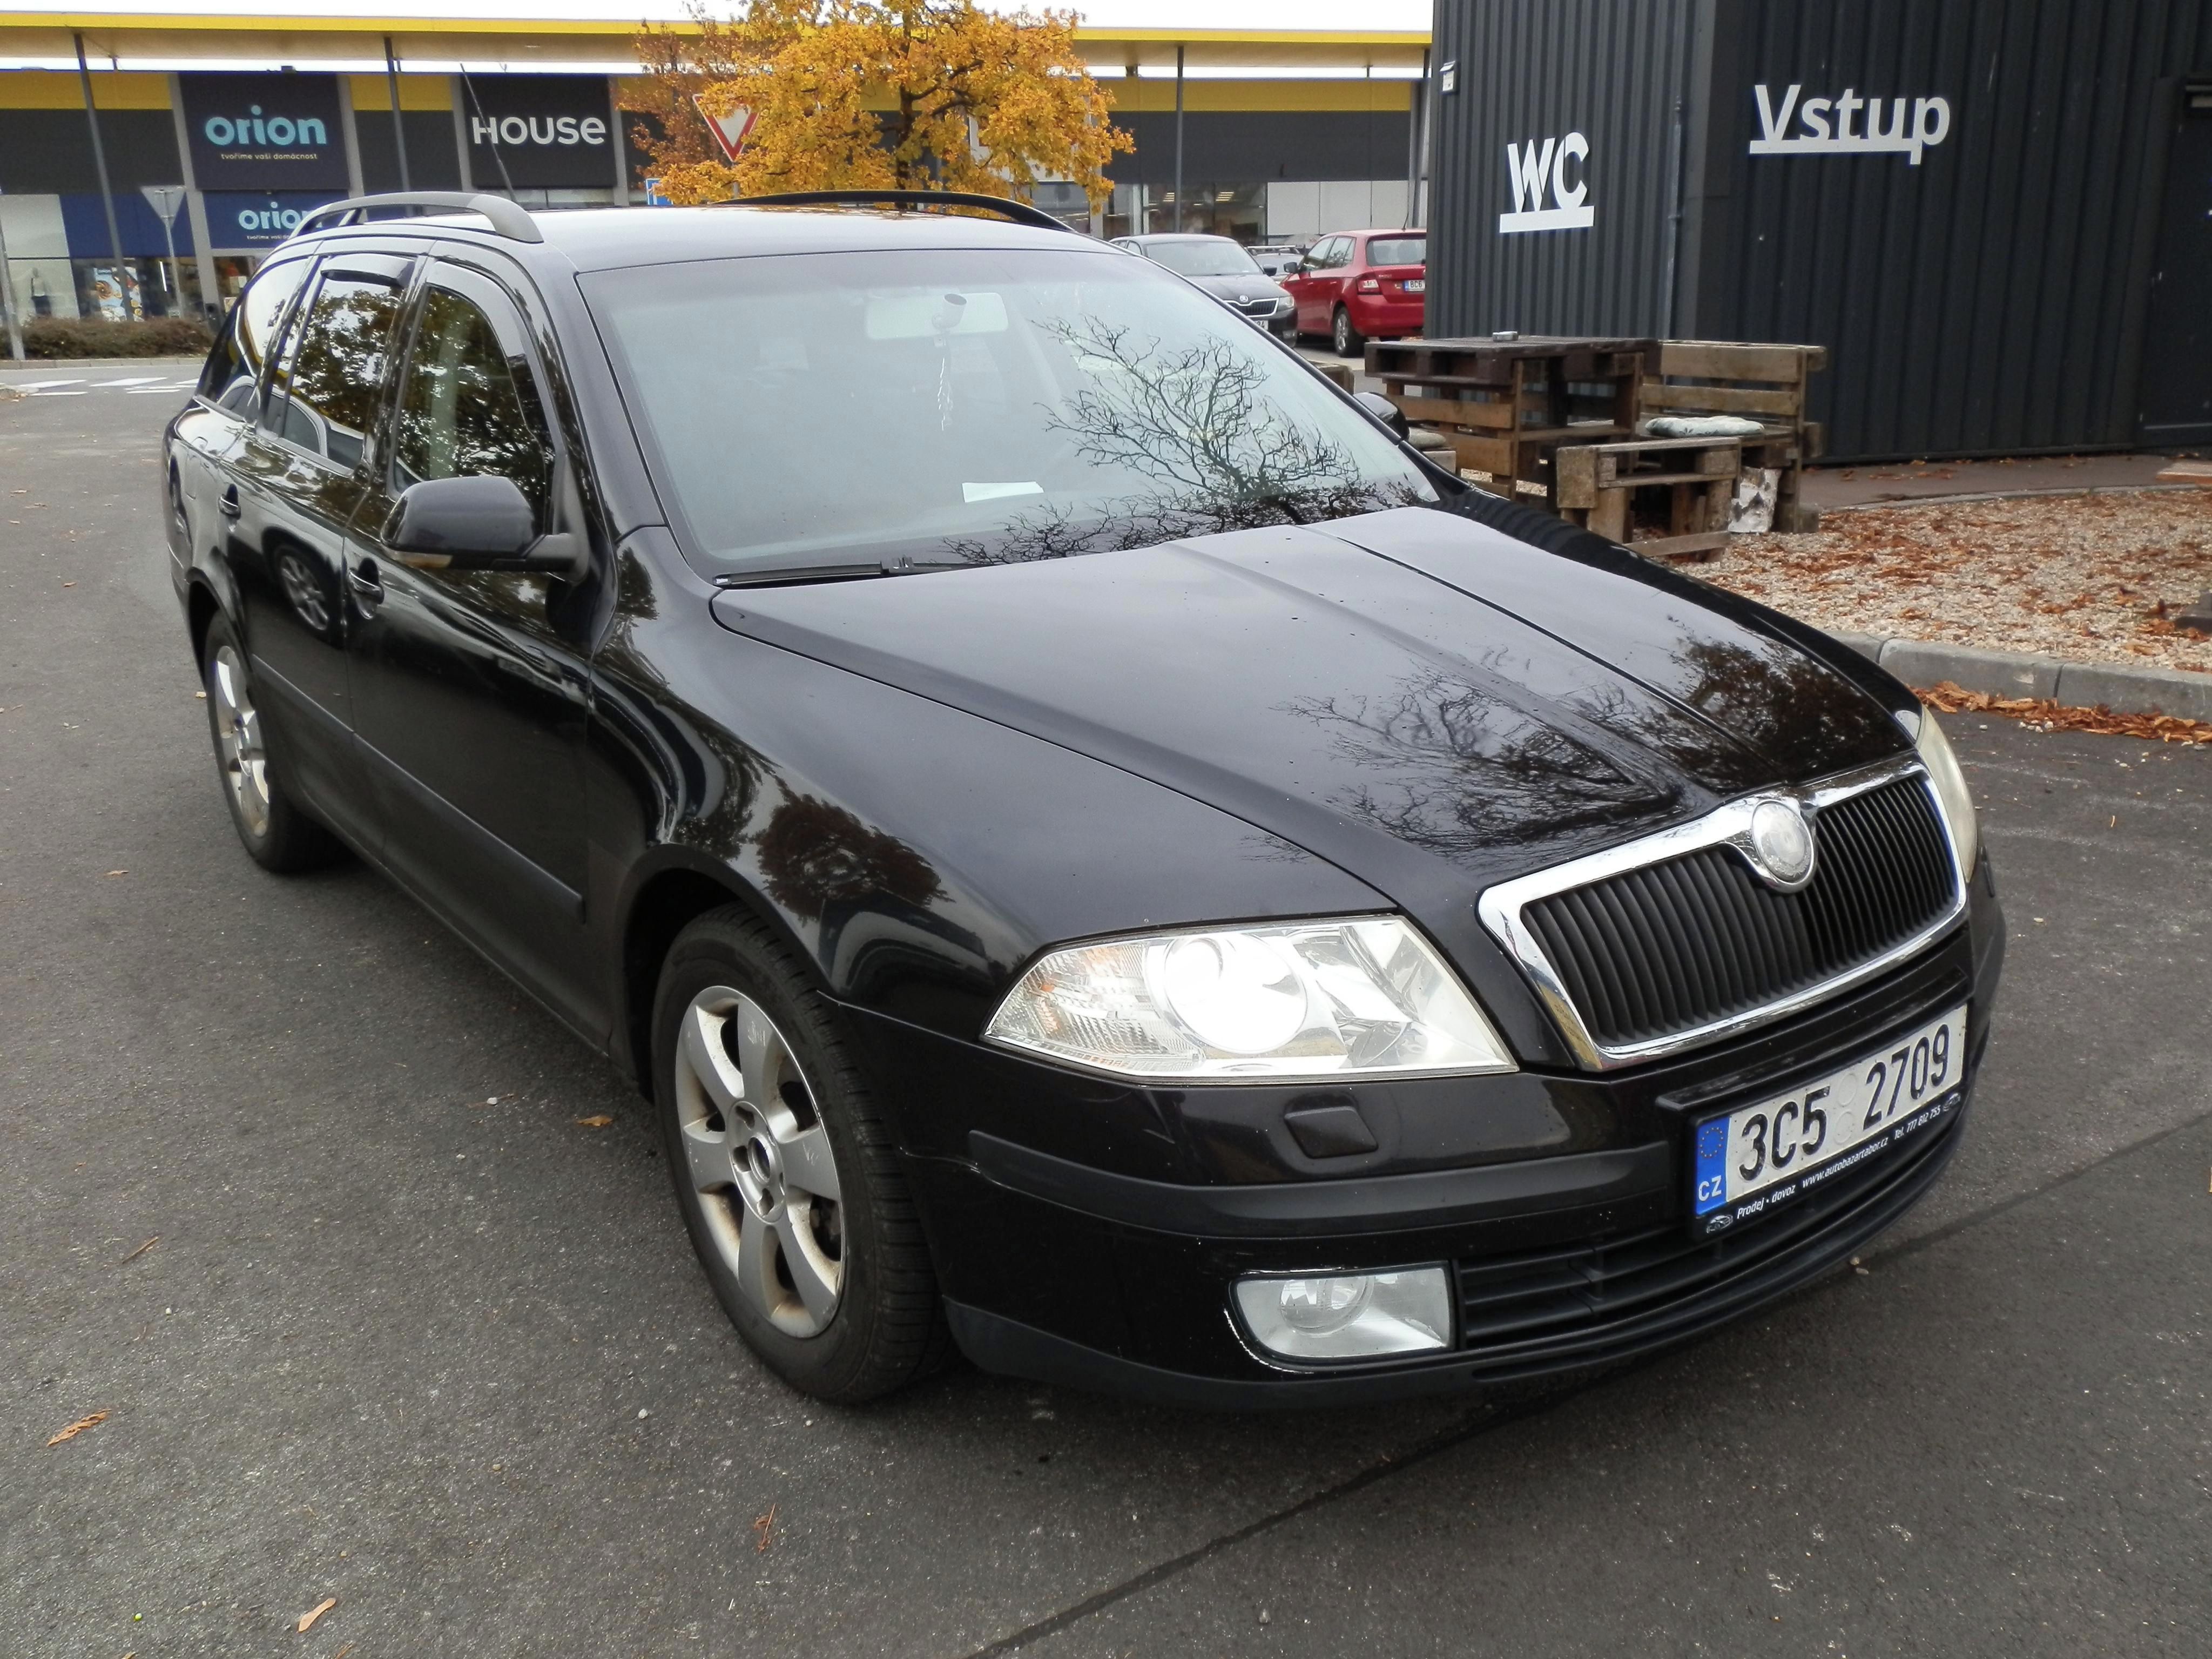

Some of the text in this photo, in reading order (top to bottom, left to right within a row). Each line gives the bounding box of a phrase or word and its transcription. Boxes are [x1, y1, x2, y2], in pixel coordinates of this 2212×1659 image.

[206, 105, 326, 145] orion
[1755, 84, 1950, 164] Vstup
[1507, 132, 1589, 214] WC
[1739, 1024, 1949, 1181] 3C5 2709
[1698, 1175, 1722, 1201] CZ
[1737, 1197, 1765, 1219] Prodej
[1772, 1185, 1796, 1203] dovoz
[1906, 1118, 1917, 1133] 777
